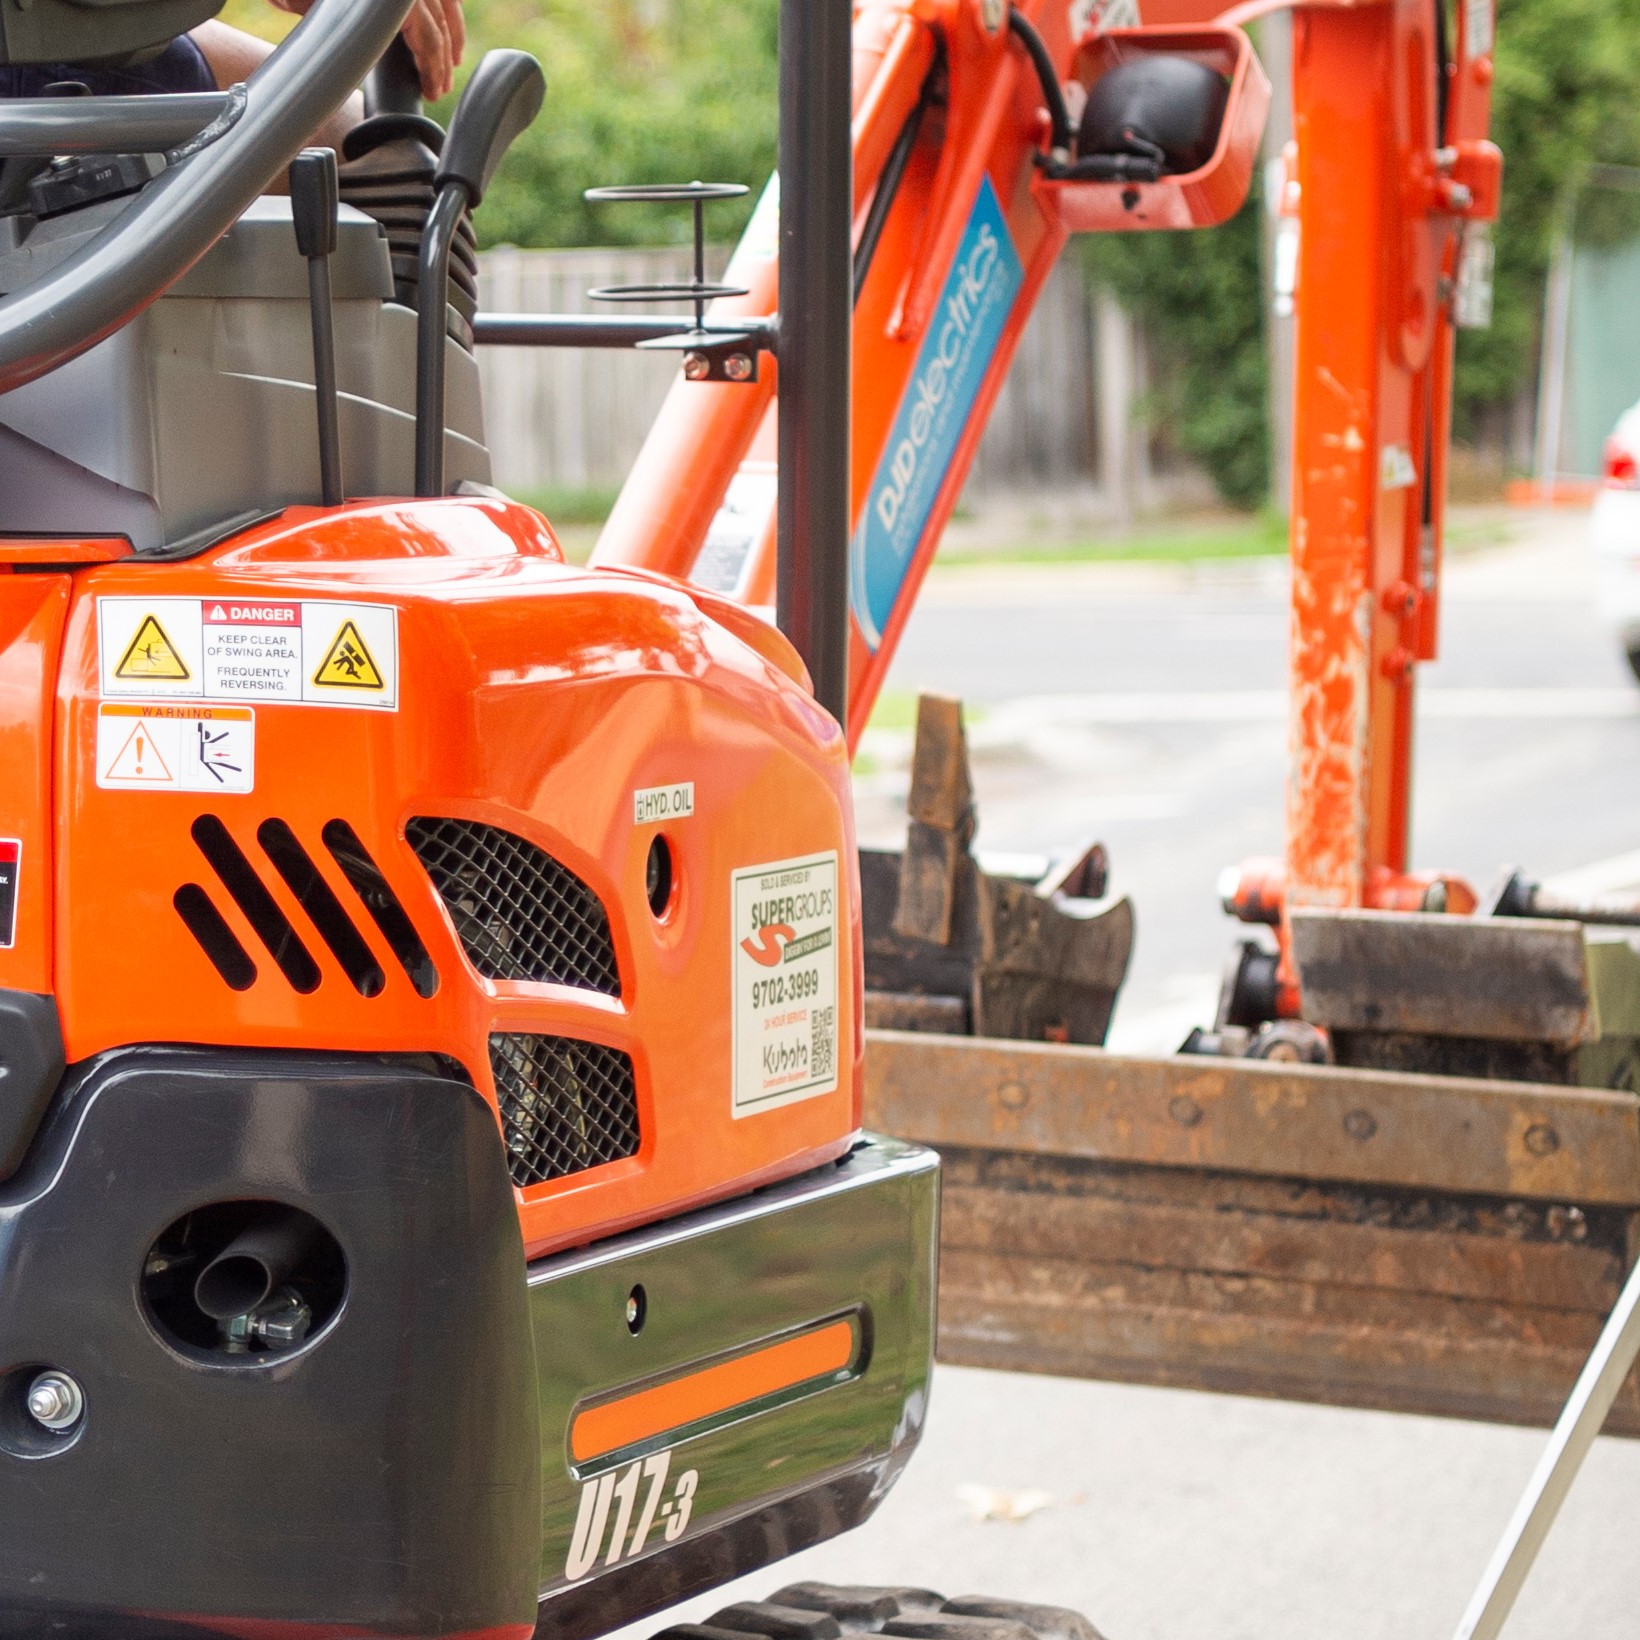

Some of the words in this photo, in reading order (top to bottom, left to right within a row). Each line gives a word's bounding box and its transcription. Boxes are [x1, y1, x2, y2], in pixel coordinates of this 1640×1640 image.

[230, 607, 294, 622] DANGER
[218, 635, 248, 645] KEEP
[250, 636, 287, 646] CLEAR
[207, 647, 223, 656] OF
[225, 648, 263, 657] SWING
[265, 649, 298, 658] AREA.
[217, 667, 290, 678] FREQUENTLY
[220, 680, 287, 690] REVERSING.
[142, 707, 212, 719] WARNING
[645, 792, 670, 817] HYD.
[673, 789, 692, 812] OIL
[752, 888, 832, 930] SUPERGROUPS
[753, 969, 818, 1009] 9702-3999
[763, 1037, 808, 1074] Kubota
[565, 1450, 699, 1581] U17-3
